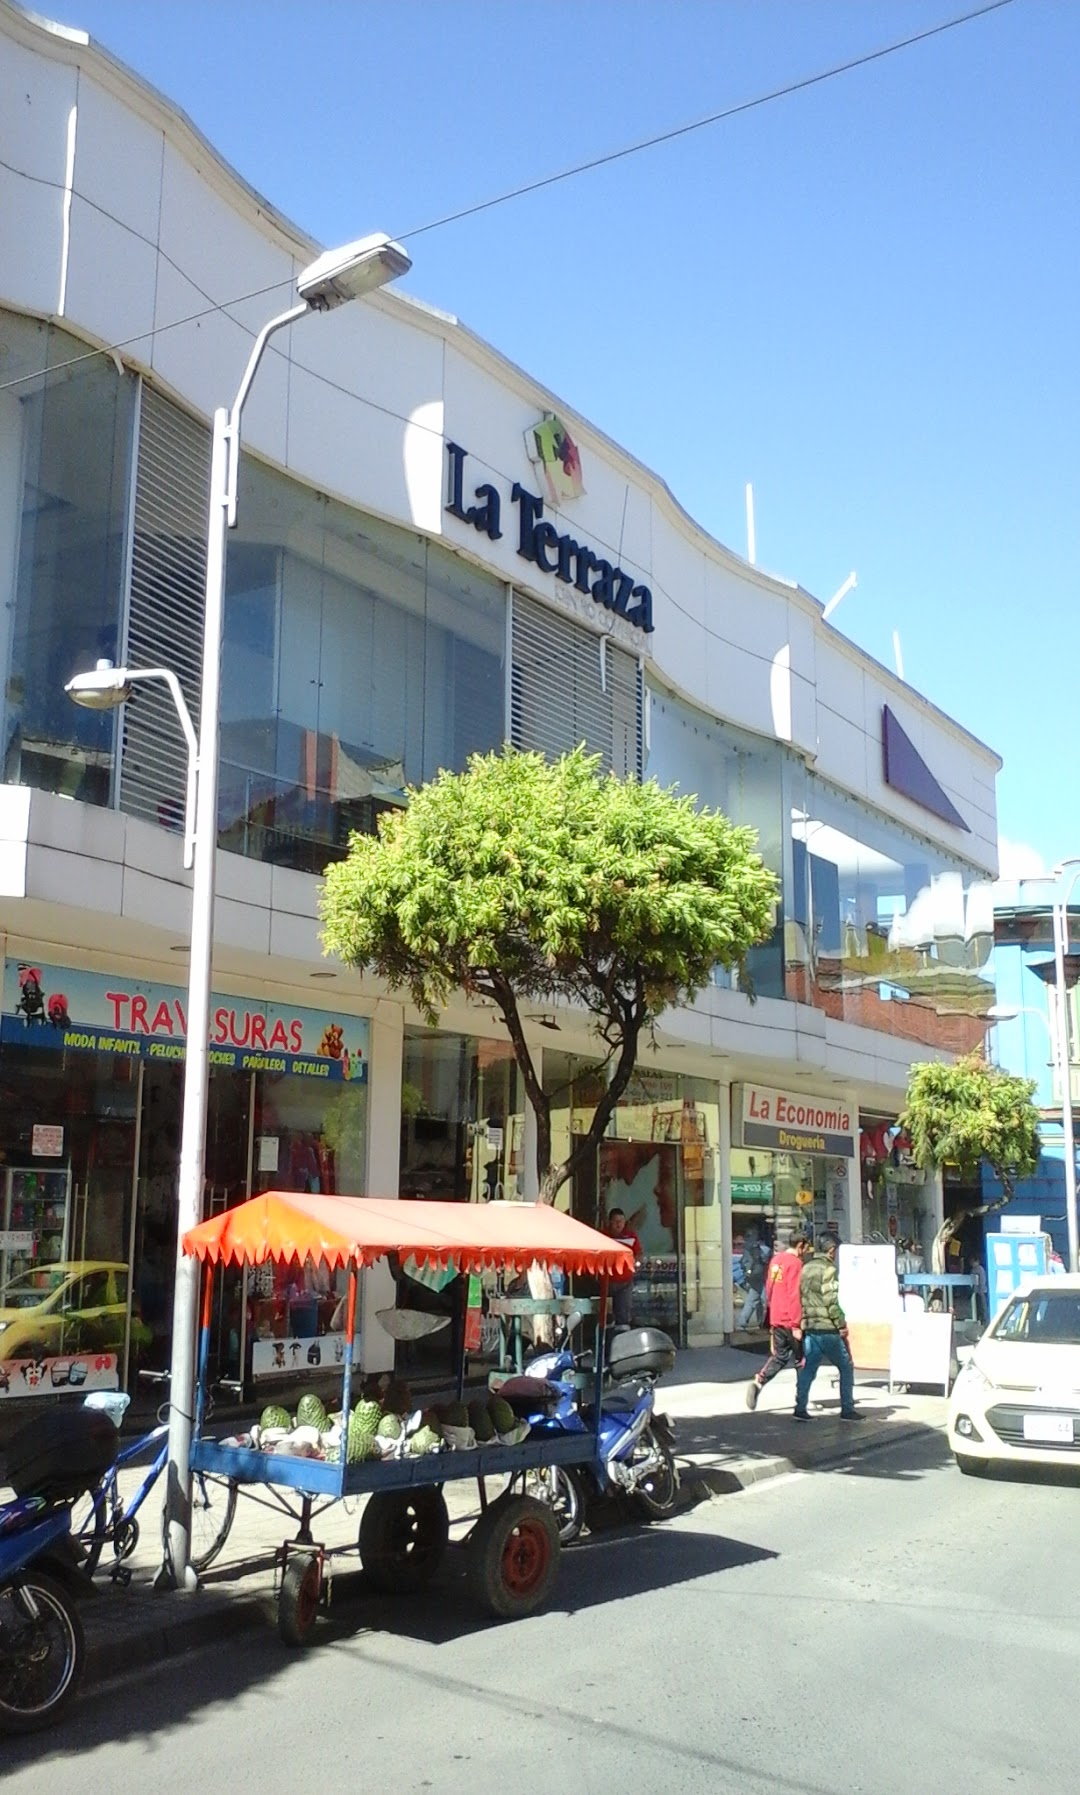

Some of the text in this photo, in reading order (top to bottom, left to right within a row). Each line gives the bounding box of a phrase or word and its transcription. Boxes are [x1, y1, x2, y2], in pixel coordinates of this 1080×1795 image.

[445, 442, 655, 633] La Terraza
[105, 992, 303, 1053] TRAVSURAS
[64, 1032, 96, 1050] MODA
[98, 1036, 141, 1055] INFANTIL
[292, 1060, 330, 1077] DETALLES
[749, 1091, 850, 1131] La Economía
